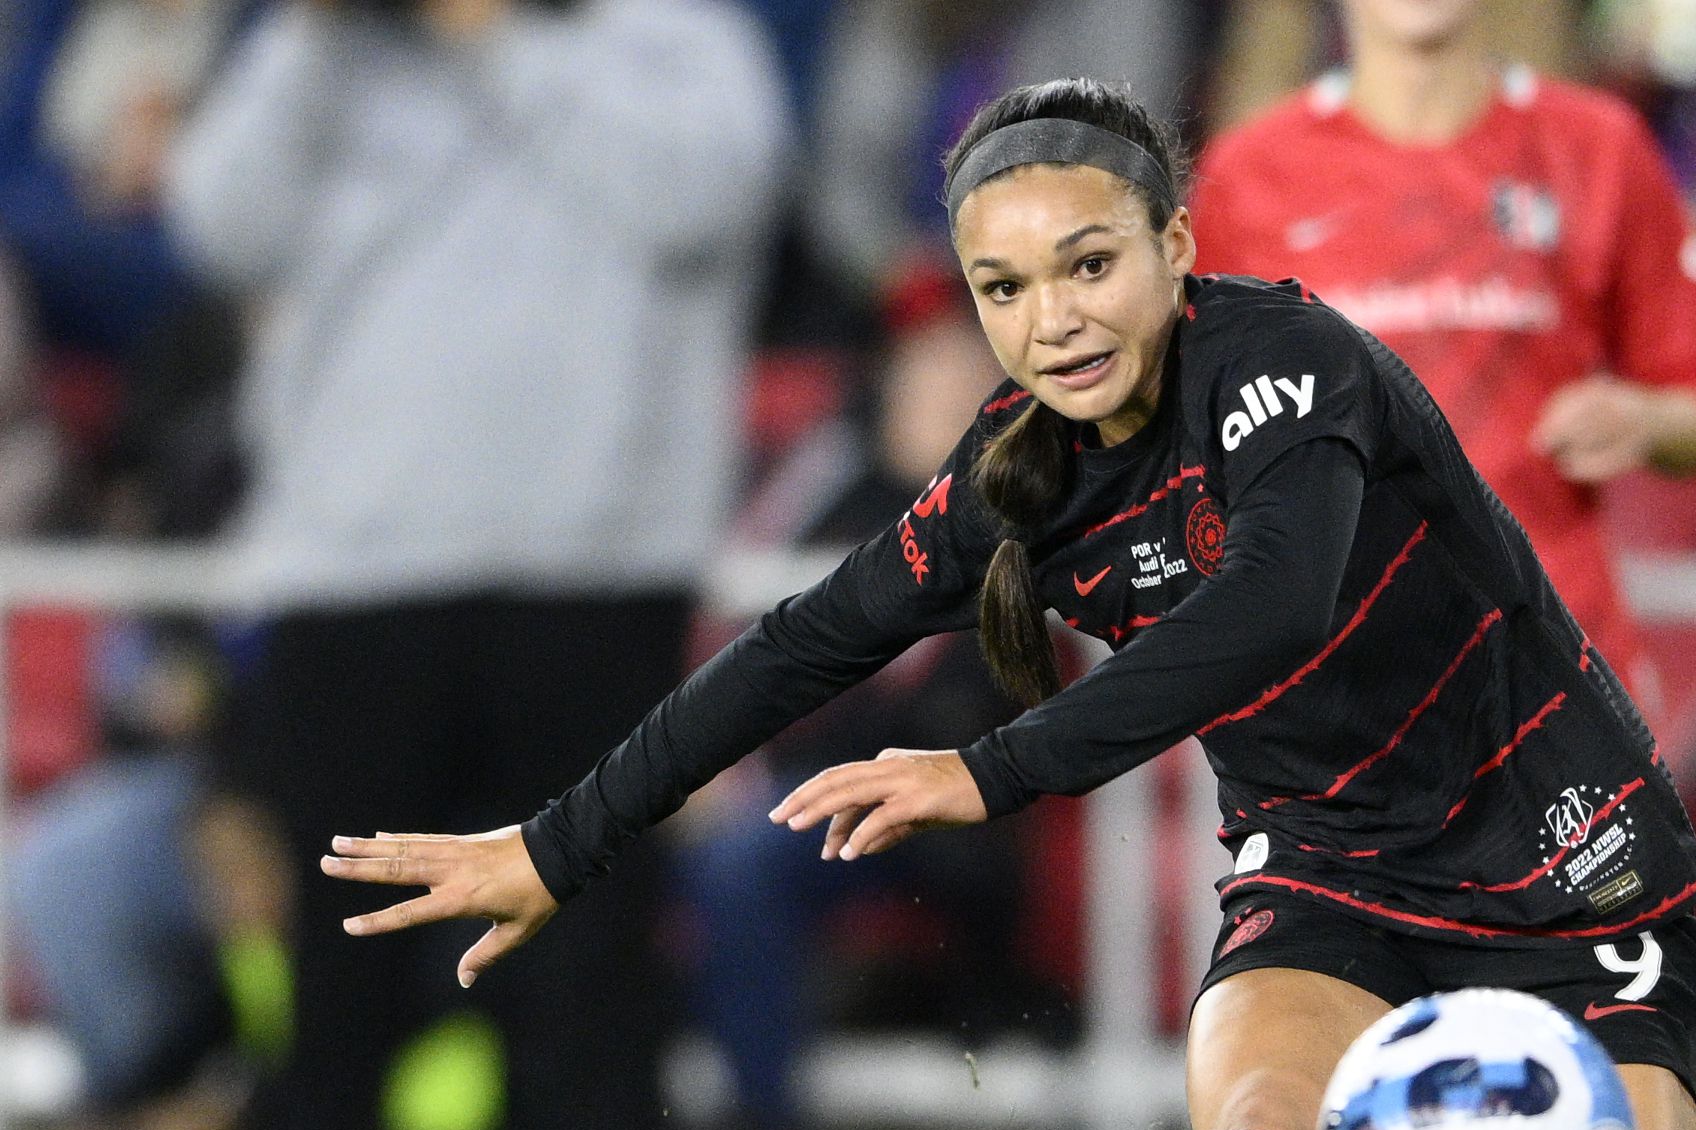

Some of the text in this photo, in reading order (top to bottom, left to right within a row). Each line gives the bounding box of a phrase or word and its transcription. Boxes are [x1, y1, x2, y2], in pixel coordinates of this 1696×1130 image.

[1222, 374, 1315, 452] ally
[1131, 542, 1152, 559] POR
[1139, 556, 1159, 573] Audi
[1131, 574, 1162, 590] October
[1564, 823, 1624, 877] 2022 NWSL
[1570, 832, 1627, 886] CHAMPIONSHIP
[1593, 930, 1663, 1002] 9
